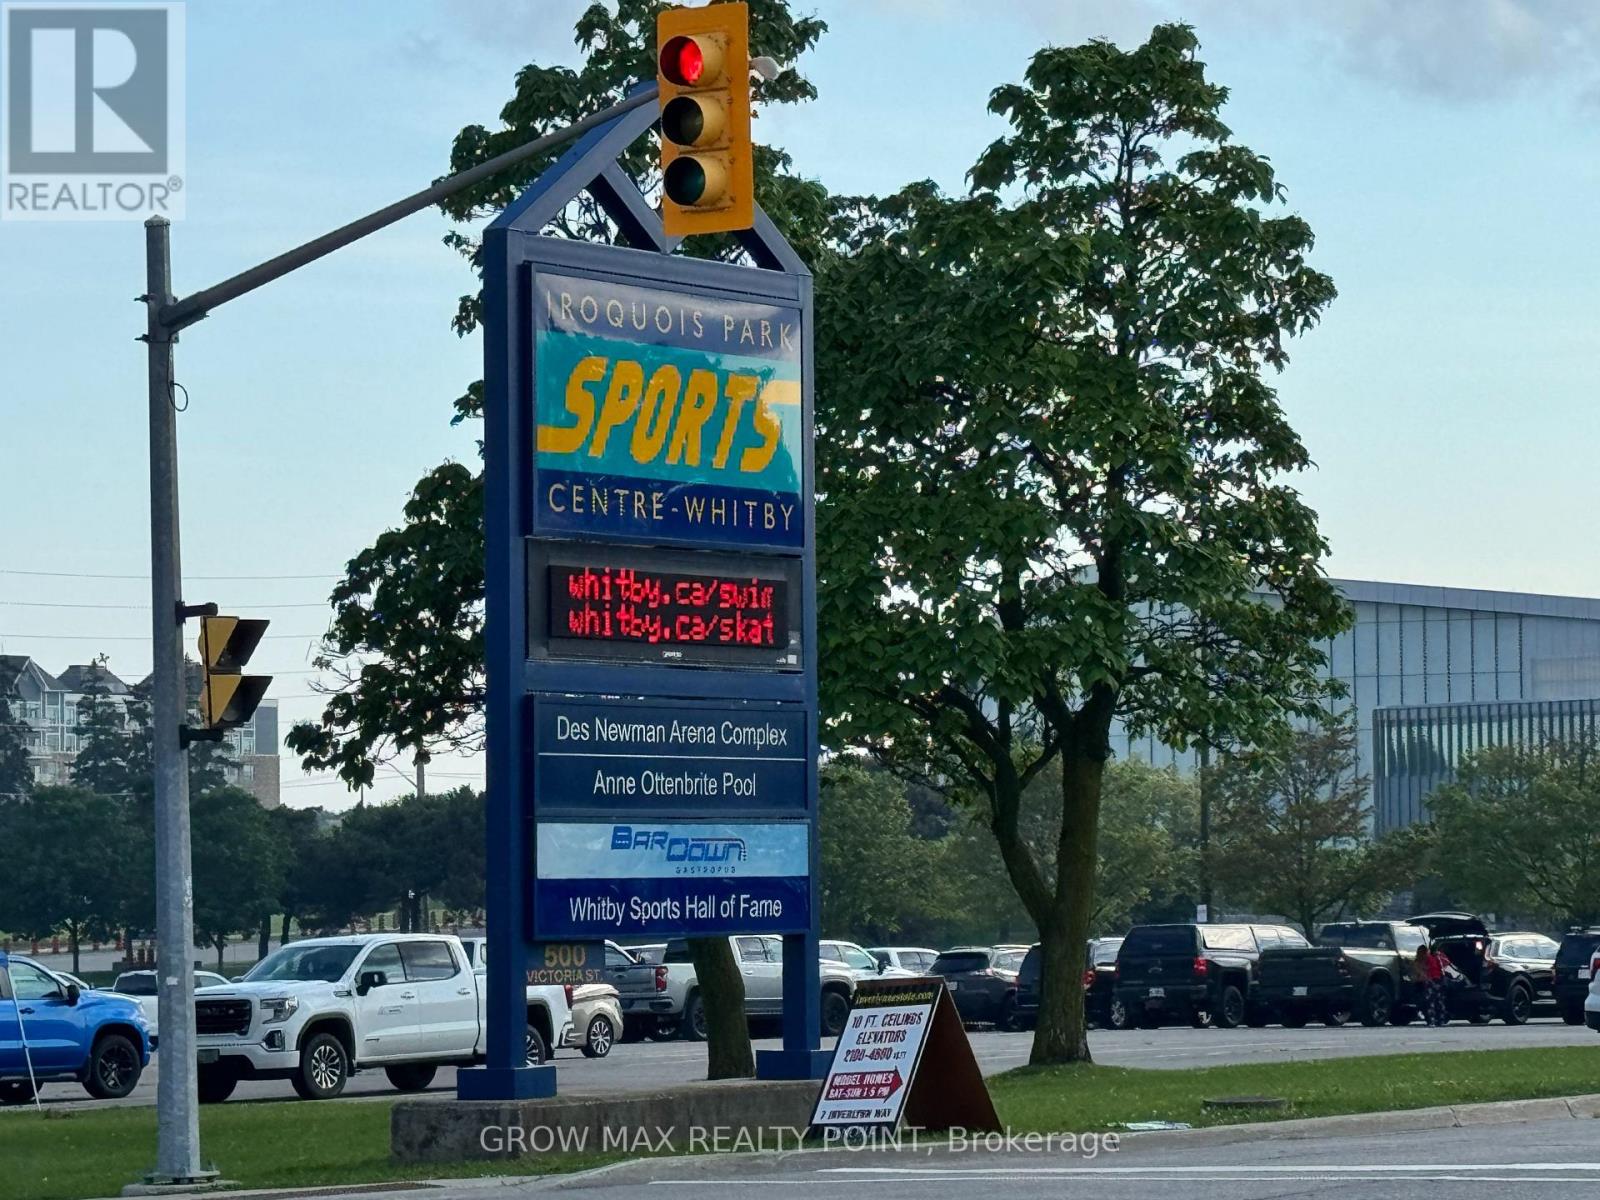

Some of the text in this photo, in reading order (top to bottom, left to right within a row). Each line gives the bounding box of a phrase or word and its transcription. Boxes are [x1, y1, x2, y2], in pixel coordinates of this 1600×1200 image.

[546, 290, 794, 351] IROQUOIS PARK
[536, 356, 801, 472] SPORTS
[556, 715, 788, 751] Des Newman Arena Complex
[593, 770, 757, 796] Anne Ottenbrite Pool
[569, 894, 783, 926] Whitby Sports Hall of Fame
[544, 944, 586, 967] 500
[526, 969, 583, 983] VICTORIA
[851, 1015, 862, 1029] 10
[881, 1011, 924, 1028] CEILINGS
[855, 1029, 907, 1045] ELEVATORS
[832, 1072, 895, 1086] MODEL HOMES
